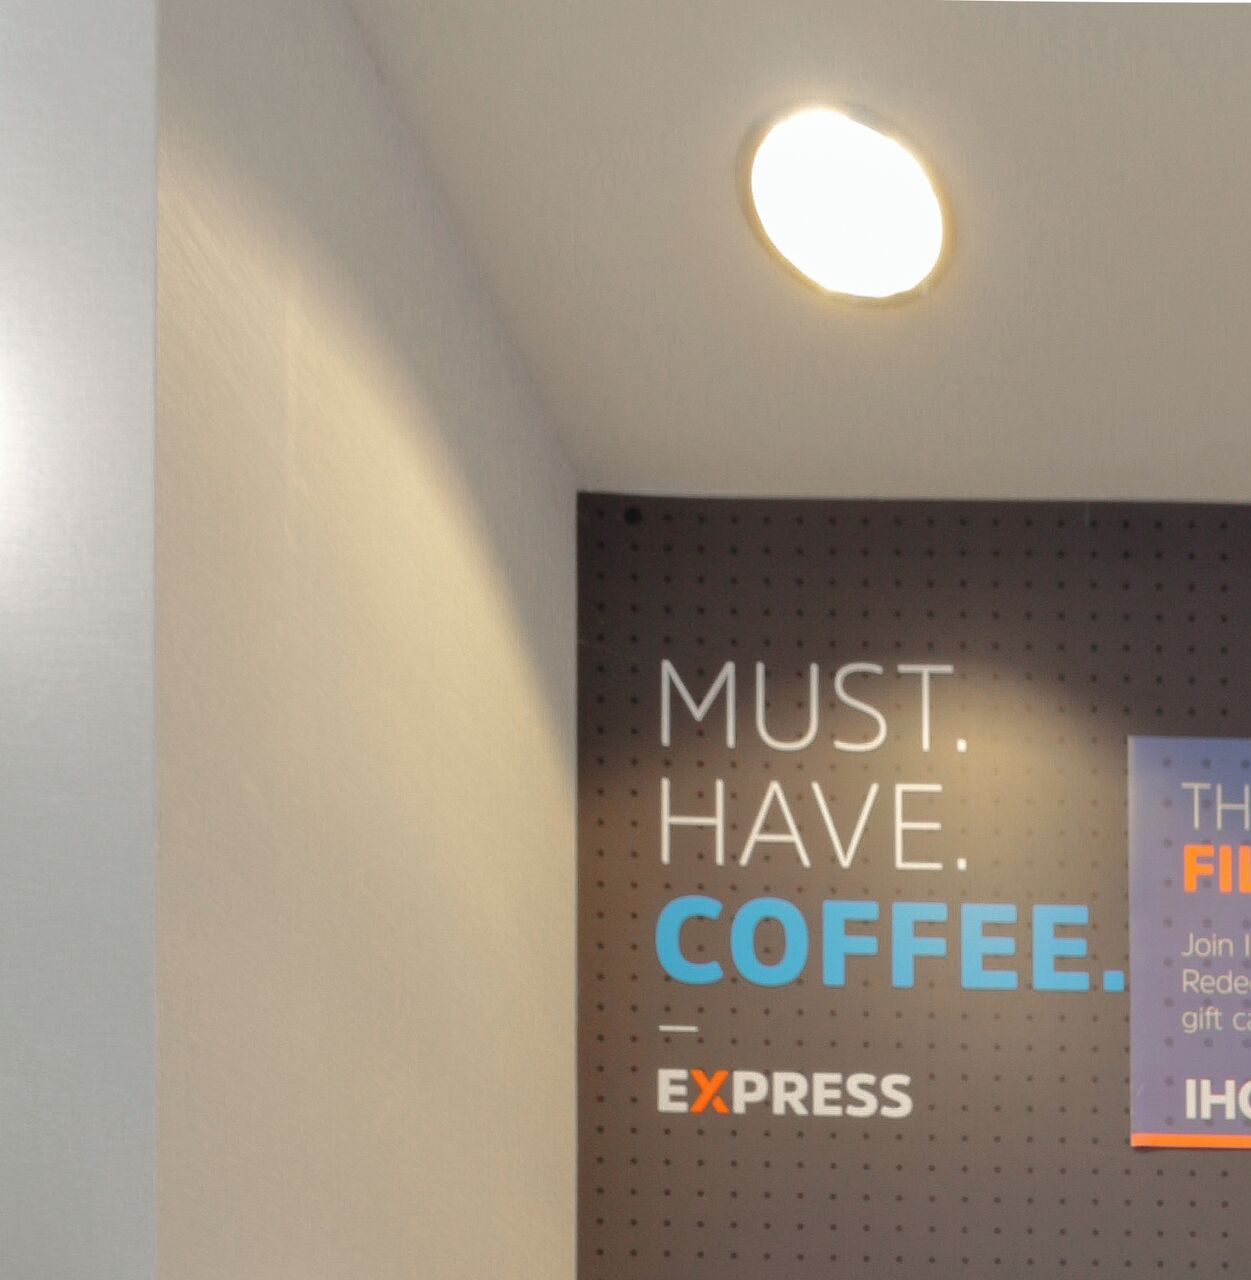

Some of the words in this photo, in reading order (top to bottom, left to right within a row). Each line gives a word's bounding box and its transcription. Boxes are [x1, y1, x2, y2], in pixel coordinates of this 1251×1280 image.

[661, 659, 967, 752] MUST.
[661, 777, 967, 870] HAVE.
[655, 894, 1124, 992] COFFEE.
[1181, 933, 1234, 958] Join
[1182, 1007, 1223, 1033] gift
[657, 1068, 913, 1118] EXPRESS
